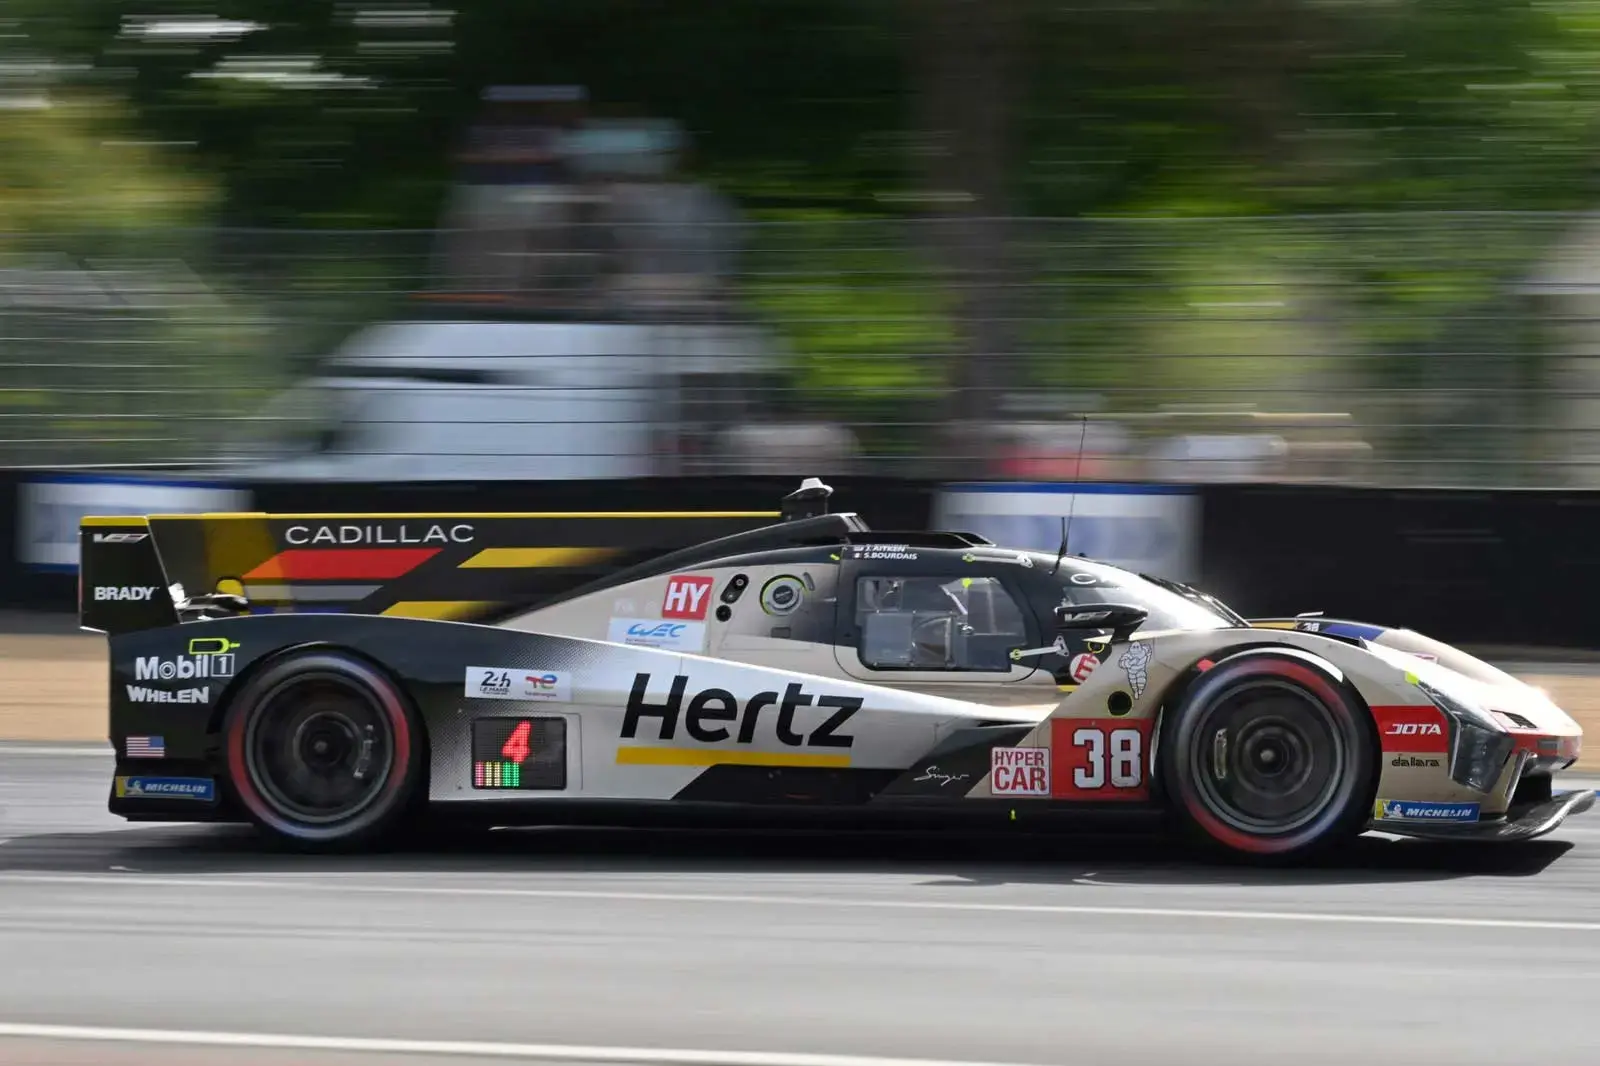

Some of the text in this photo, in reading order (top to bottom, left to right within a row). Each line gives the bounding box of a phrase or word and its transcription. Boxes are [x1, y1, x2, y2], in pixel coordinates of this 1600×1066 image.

[285, 525, 475, 544] CADILLAC
[863, 552, 918, 560] S.BOURDAIS
[94, 586, 155, 601] BRADY
[664, 582, 710, 612] HY
[627, 623, 687, 637] WEC
[135, 654, 228, 680] Mobil 1
[1074, 654, 1098, 682] E
[126, 684, 209, 703] WHELEN
[620, 673, 864, 747] Hertz
[1385, 723, 1442, 735] JOTA
[501, 719, 531, 764] 4
[994, 751, 1044, 766] HYPER
[1072, 728, 1142, 788] 38
[1392, 756, 1440, 767] dallara
[145, 783, 207, 793] MICHELIN
[994, 767, 1047, 791] CAR
[1406, 807, 1472, 817] MICHELIN
